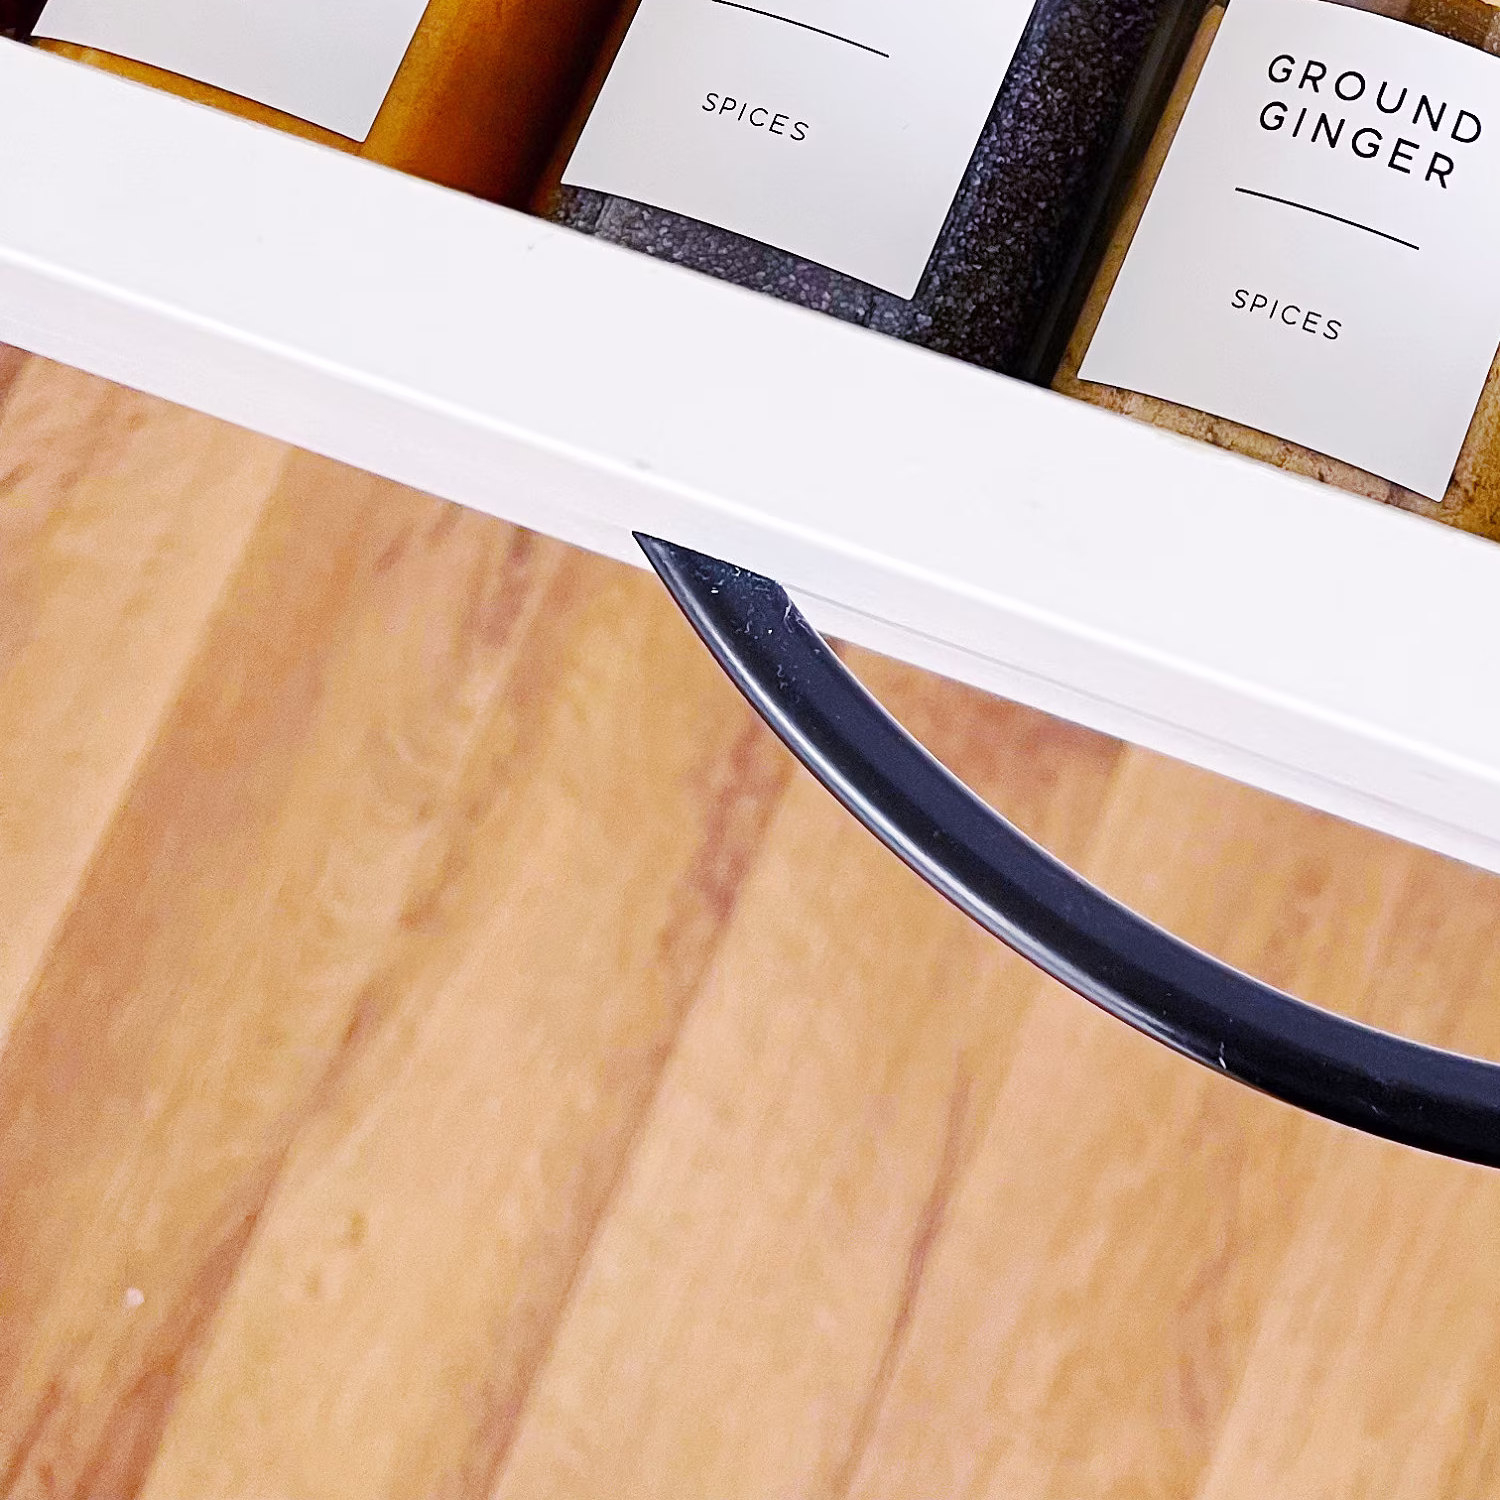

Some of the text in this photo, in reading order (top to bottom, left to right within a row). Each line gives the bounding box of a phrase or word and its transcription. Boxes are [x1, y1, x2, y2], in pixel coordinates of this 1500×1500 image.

[701, 92, 810, 142] SPICES
[1267, 53, 1482, 144] GROUND
[1259, 100, 1455, 190] GINGER
[1230, 288, 1343, 341] SPICES
